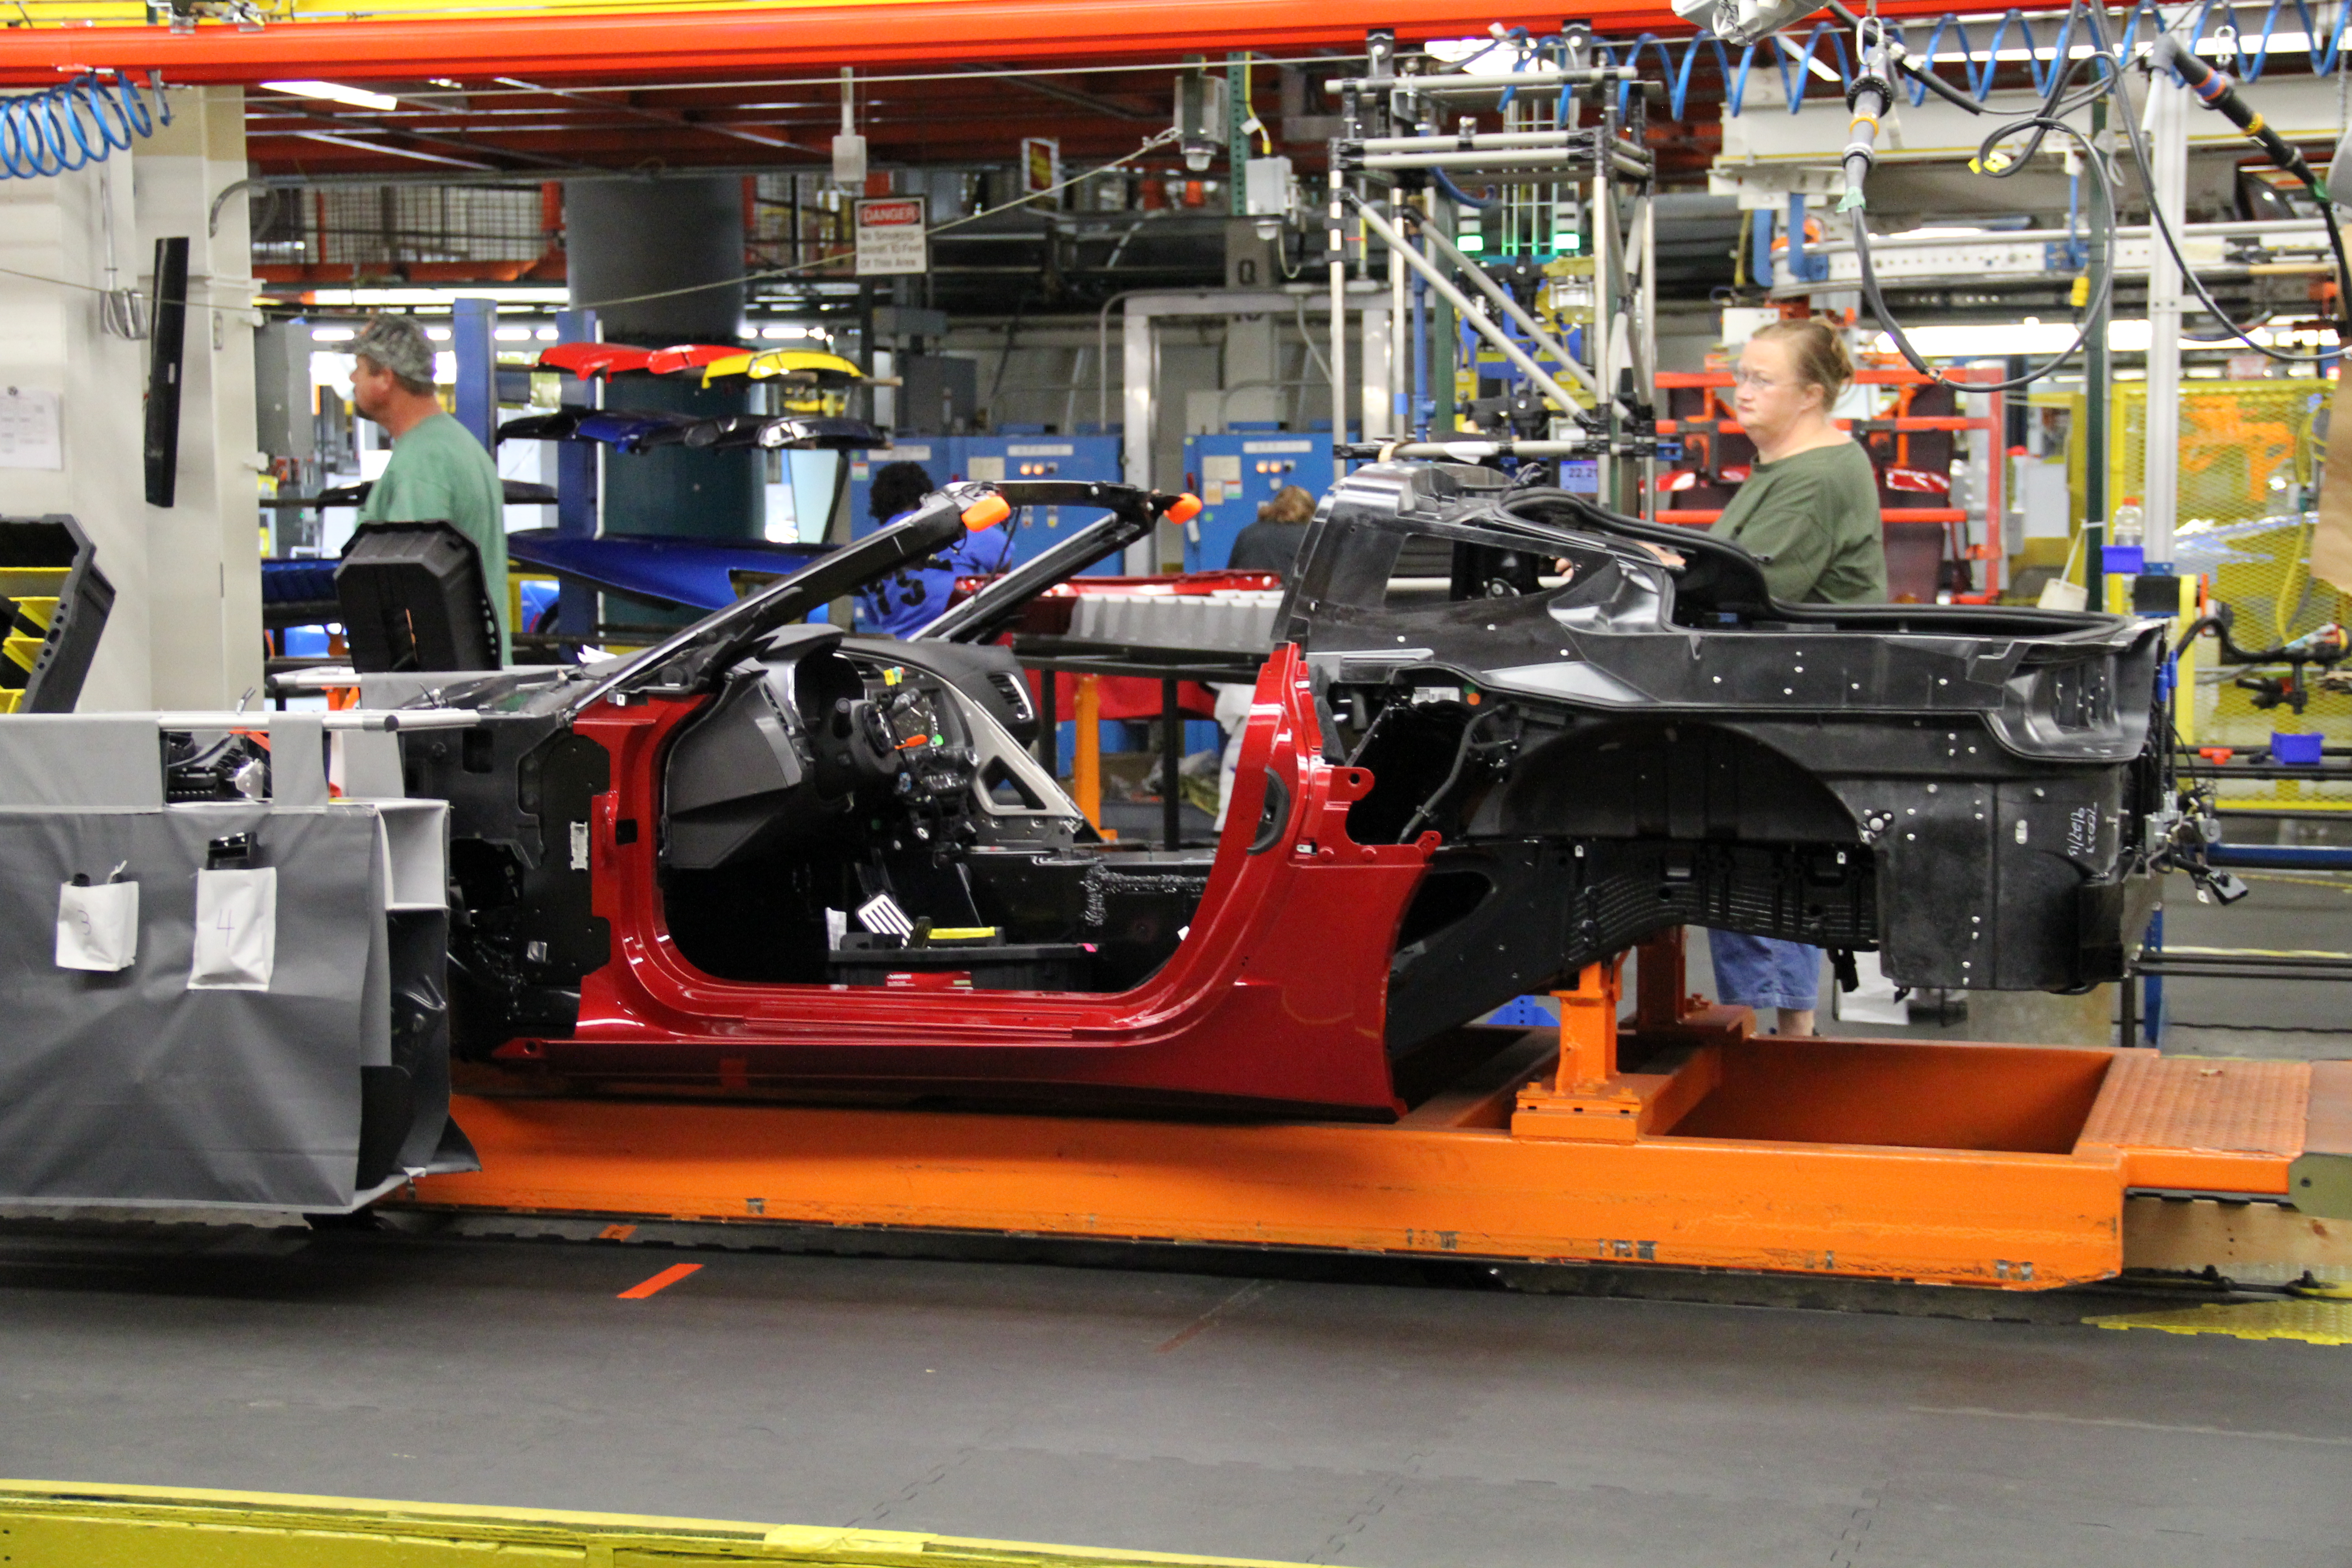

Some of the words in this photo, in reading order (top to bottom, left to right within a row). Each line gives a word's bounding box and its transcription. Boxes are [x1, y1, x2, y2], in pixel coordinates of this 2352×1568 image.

[862, 206, 917, 222] DANGER
[78, 910, 91, 936] 3
[216, 908, 235, 947] 4
